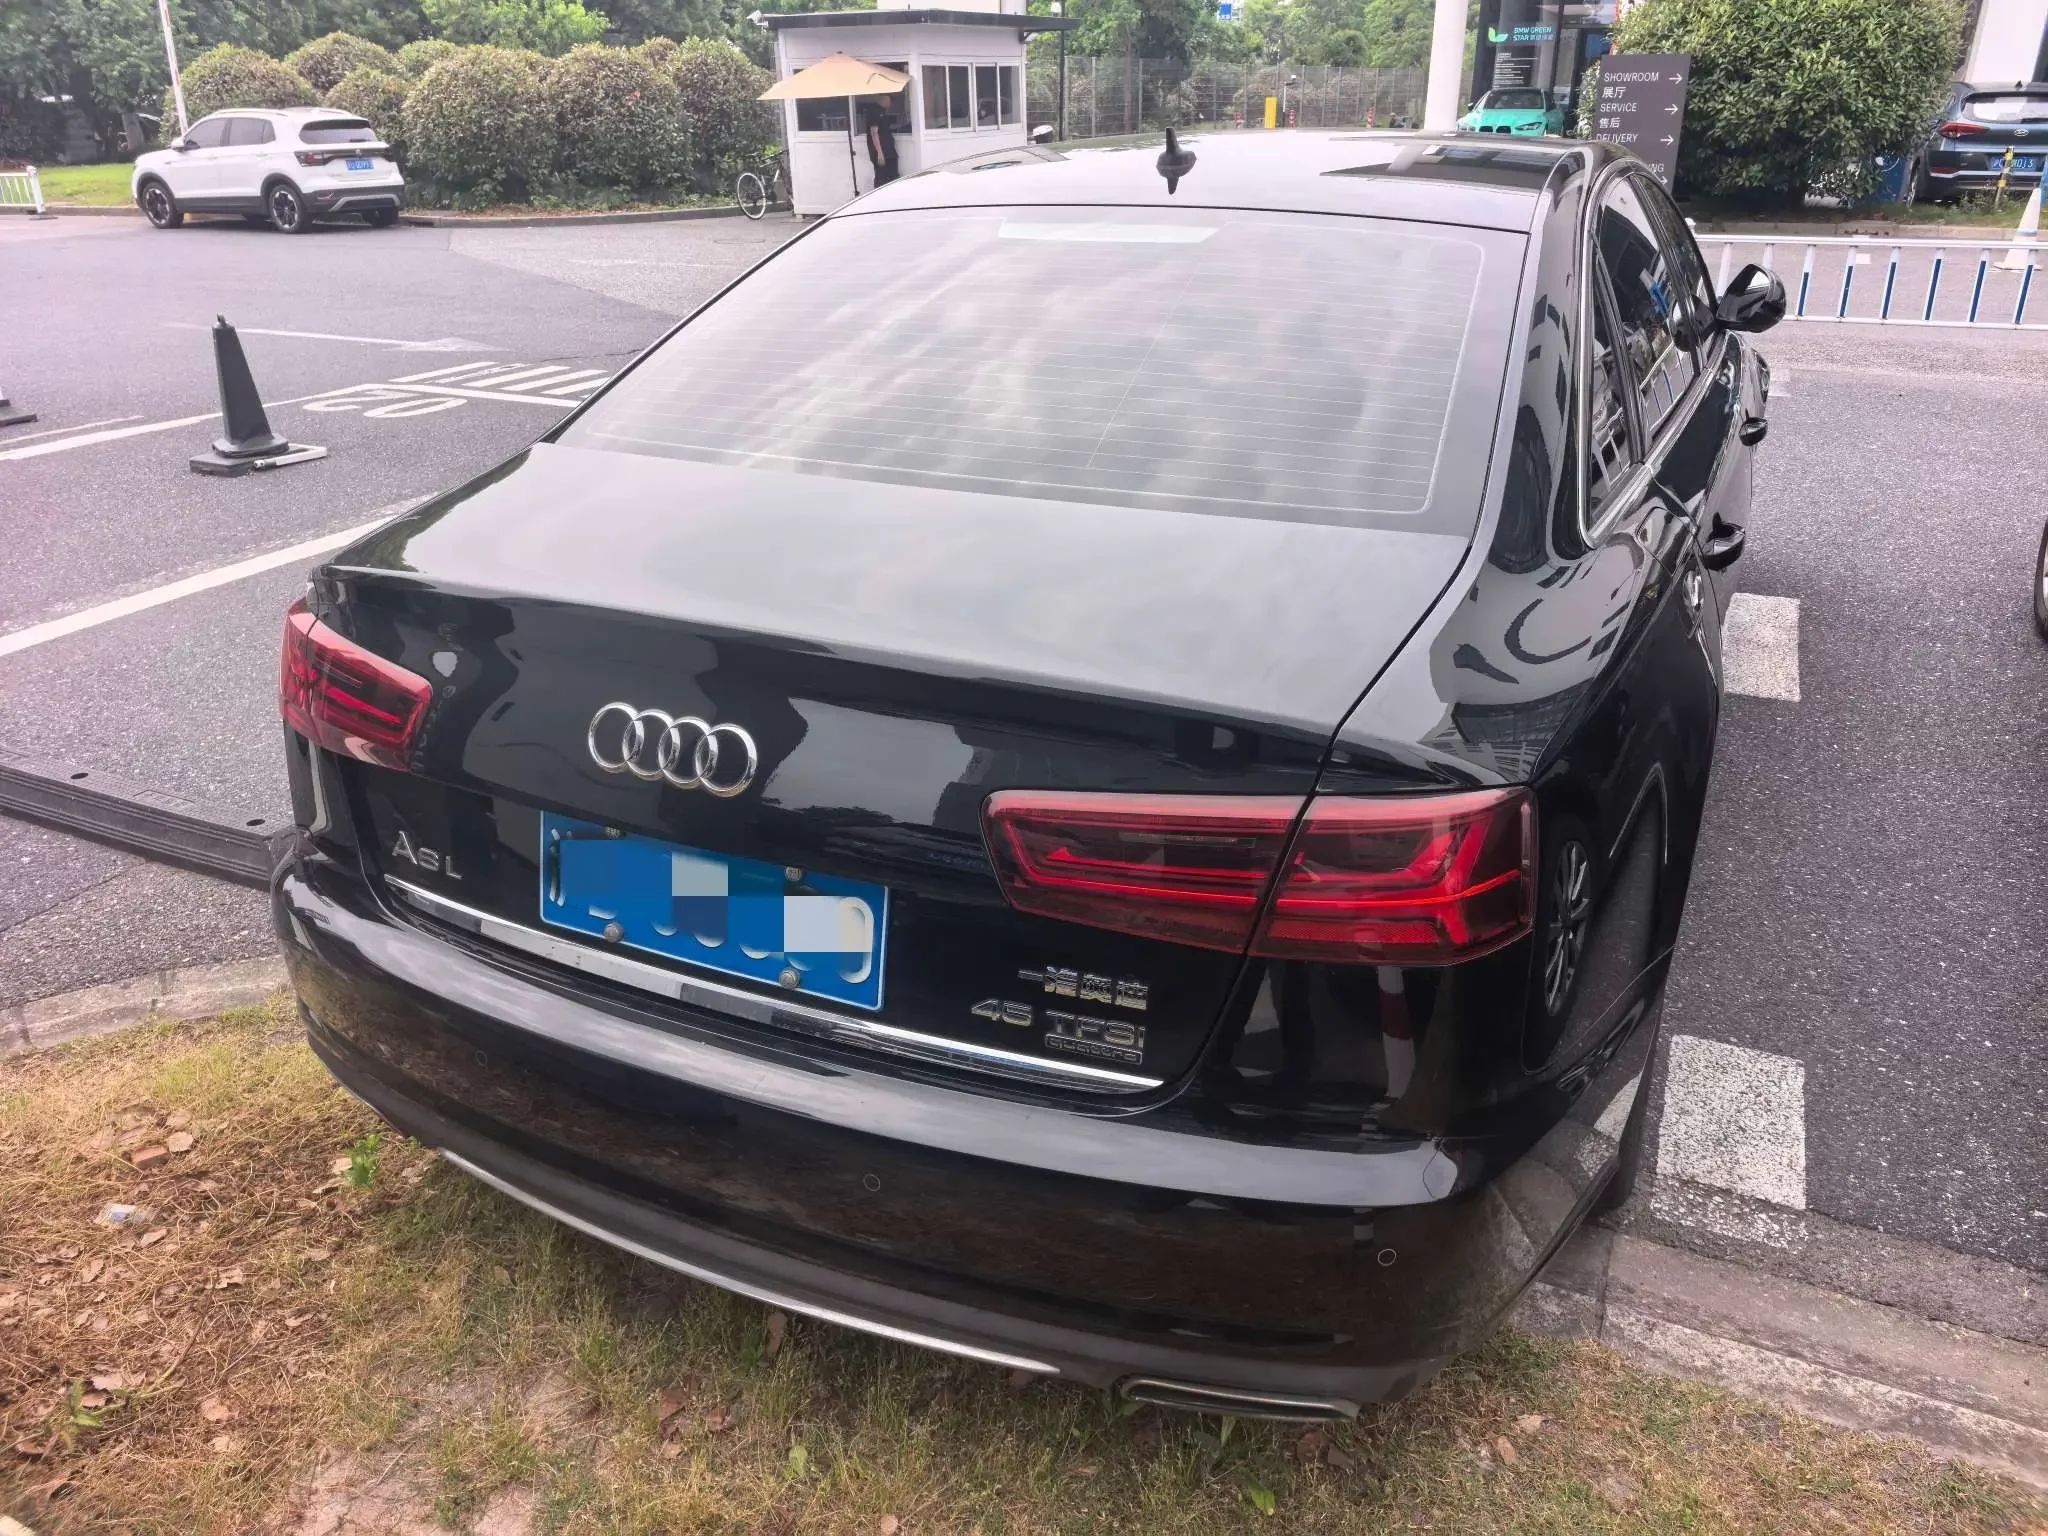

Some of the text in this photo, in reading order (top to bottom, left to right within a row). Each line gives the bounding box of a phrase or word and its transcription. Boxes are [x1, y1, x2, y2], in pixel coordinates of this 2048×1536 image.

[1530, 26, 1552, 34] GREEN
[1603, 72, 1659, 82] SHOWROOM
[1602, 86, 1626, 99] 展厅
[1600, 103, 1637, 112] SERVICE
[1599, 117, 1620, 129] 售后
[1596, 133, 1638, 144] DELIVERY
[391, 830, 463, 880] A6L
[1017, 966, 1149, 1010] 一汽奥迪
[970, 998, 1033, 1027] 45
